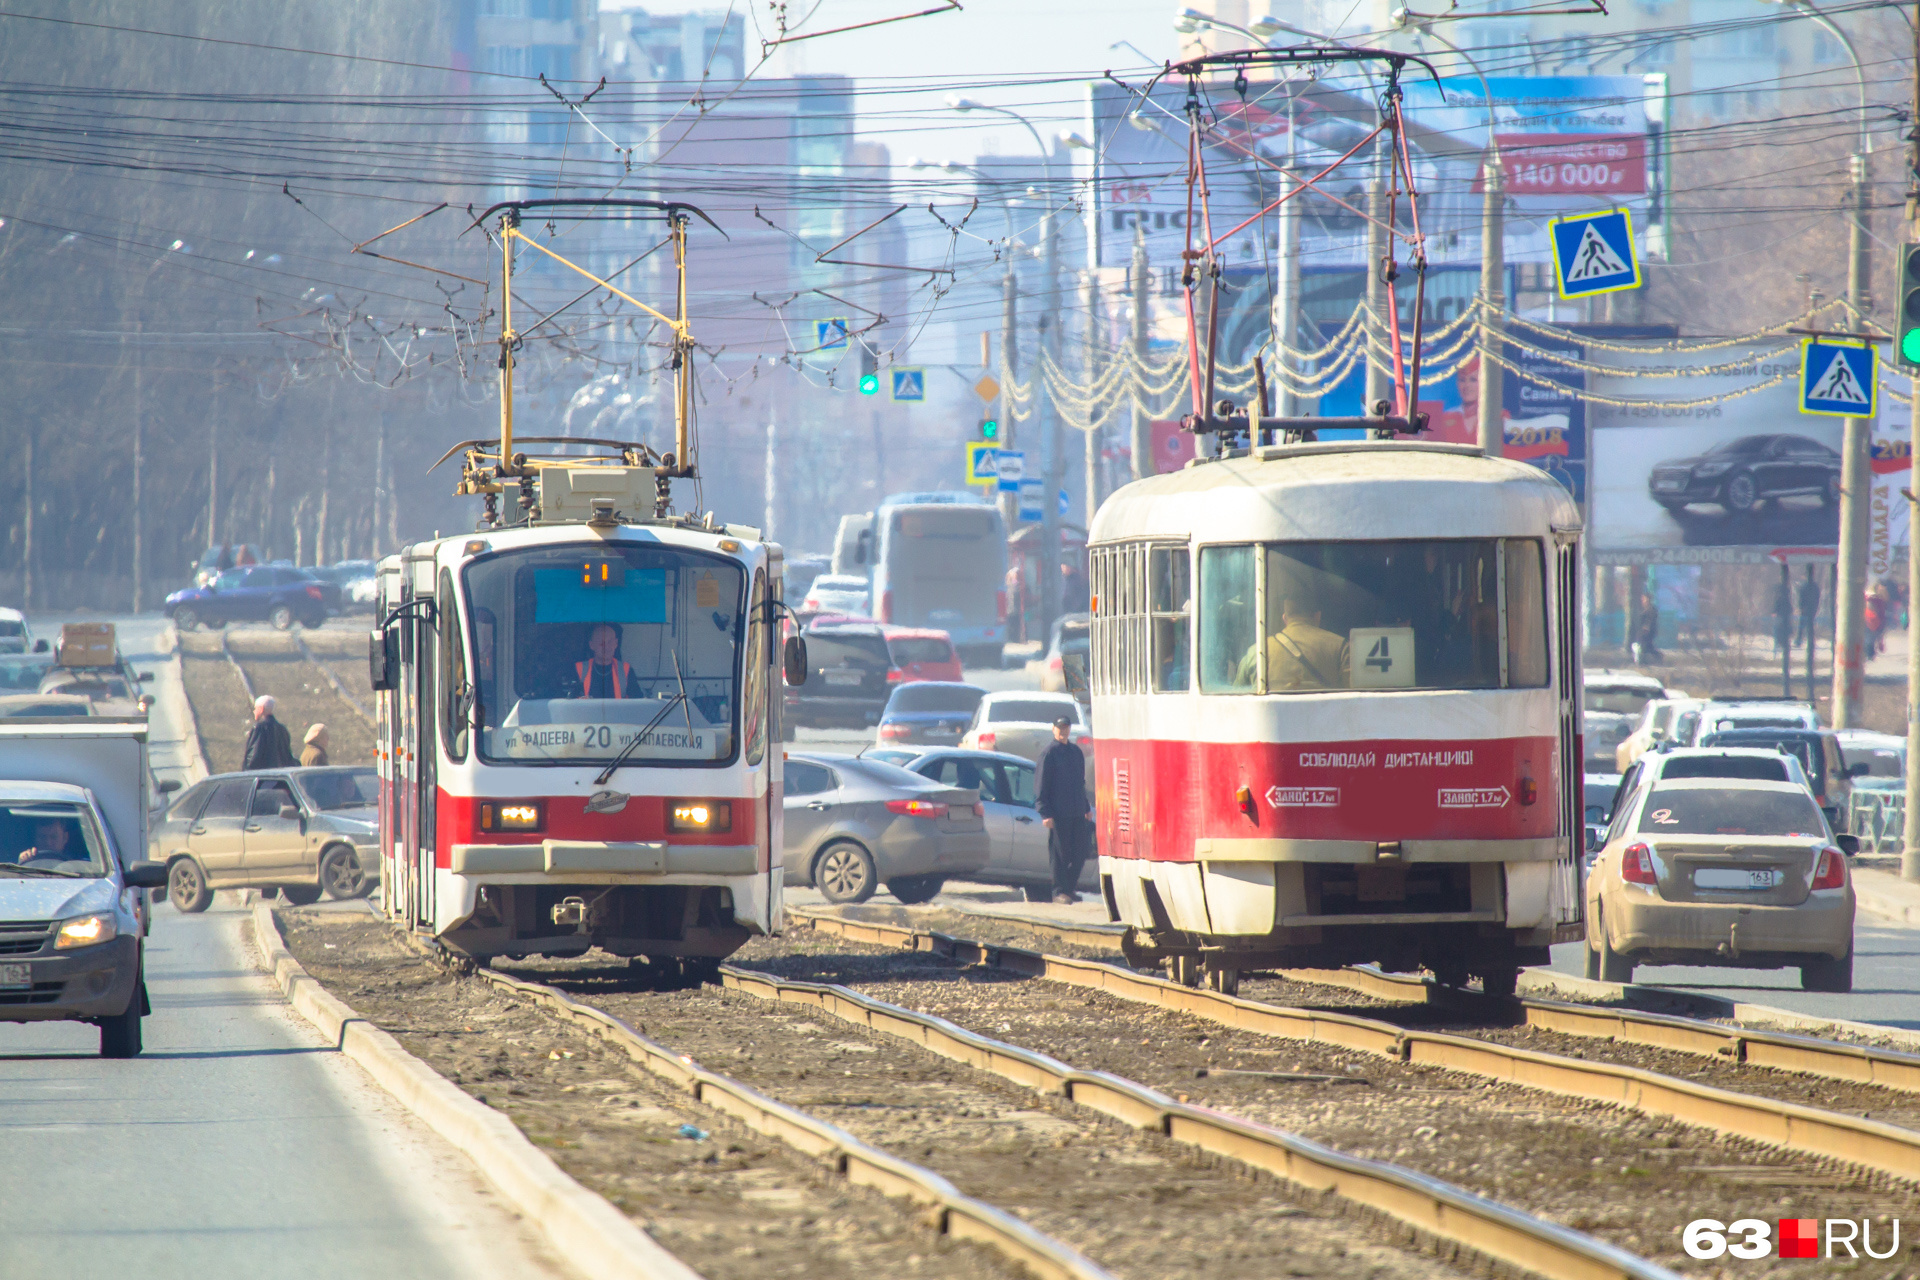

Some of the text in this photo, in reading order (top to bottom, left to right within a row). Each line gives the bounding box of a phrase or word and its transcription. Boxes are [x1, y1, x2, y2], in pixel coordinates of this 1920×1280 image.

[1503, 116, 1547, 128] седан
[1513, 164, 1557, 187] 140
[1112, 209, 1203, 234] RIO
[1696, 405, 1722, 421] руб
[1509, 426, 1563, 445] 2018
[1872, 482, 1889, 575] САМАРА
[1365, 636, 1392, 673] 4
[522, 731, 576, 747] ФАДЕЕВА
[583, 725, 611, 749] 20
[1299, 749, 1474, 769] СОБЛЮДАЙ ДИСТАНЦИЮ!
[1275, 791, 1310, 802] ЗАНОС
[1443, 792, 1479, 804] ЗАНОС
[1750, 871, 1769, 885] 163
